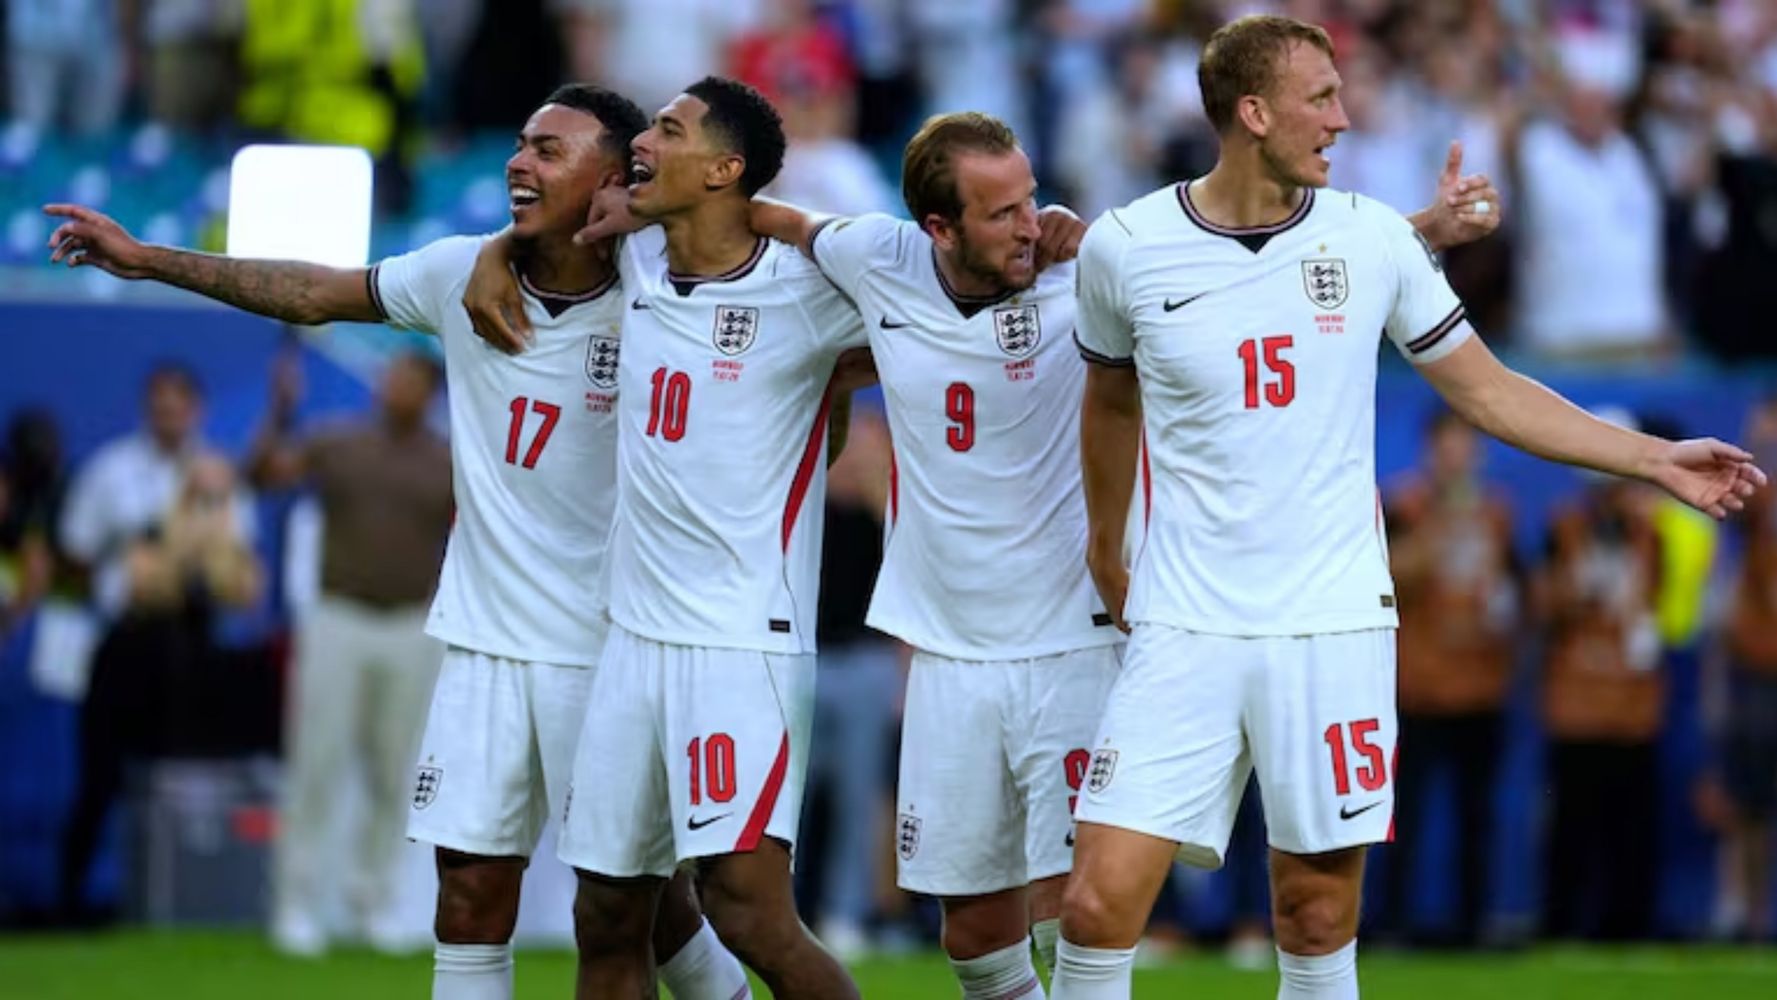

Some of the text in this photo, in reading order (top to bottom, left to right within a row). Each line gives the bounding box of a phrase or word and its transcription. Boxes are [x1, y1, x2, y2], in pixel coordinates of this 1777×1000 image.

[646, 367, 691, 442] 10
[1237, 334, 1296, 409] 15
[505, 396, 560, 468] 17
[945, 382, 974, 452] 9
[688, 733, 736, 805] 10
[1324, 717, 1387, 796] 15
